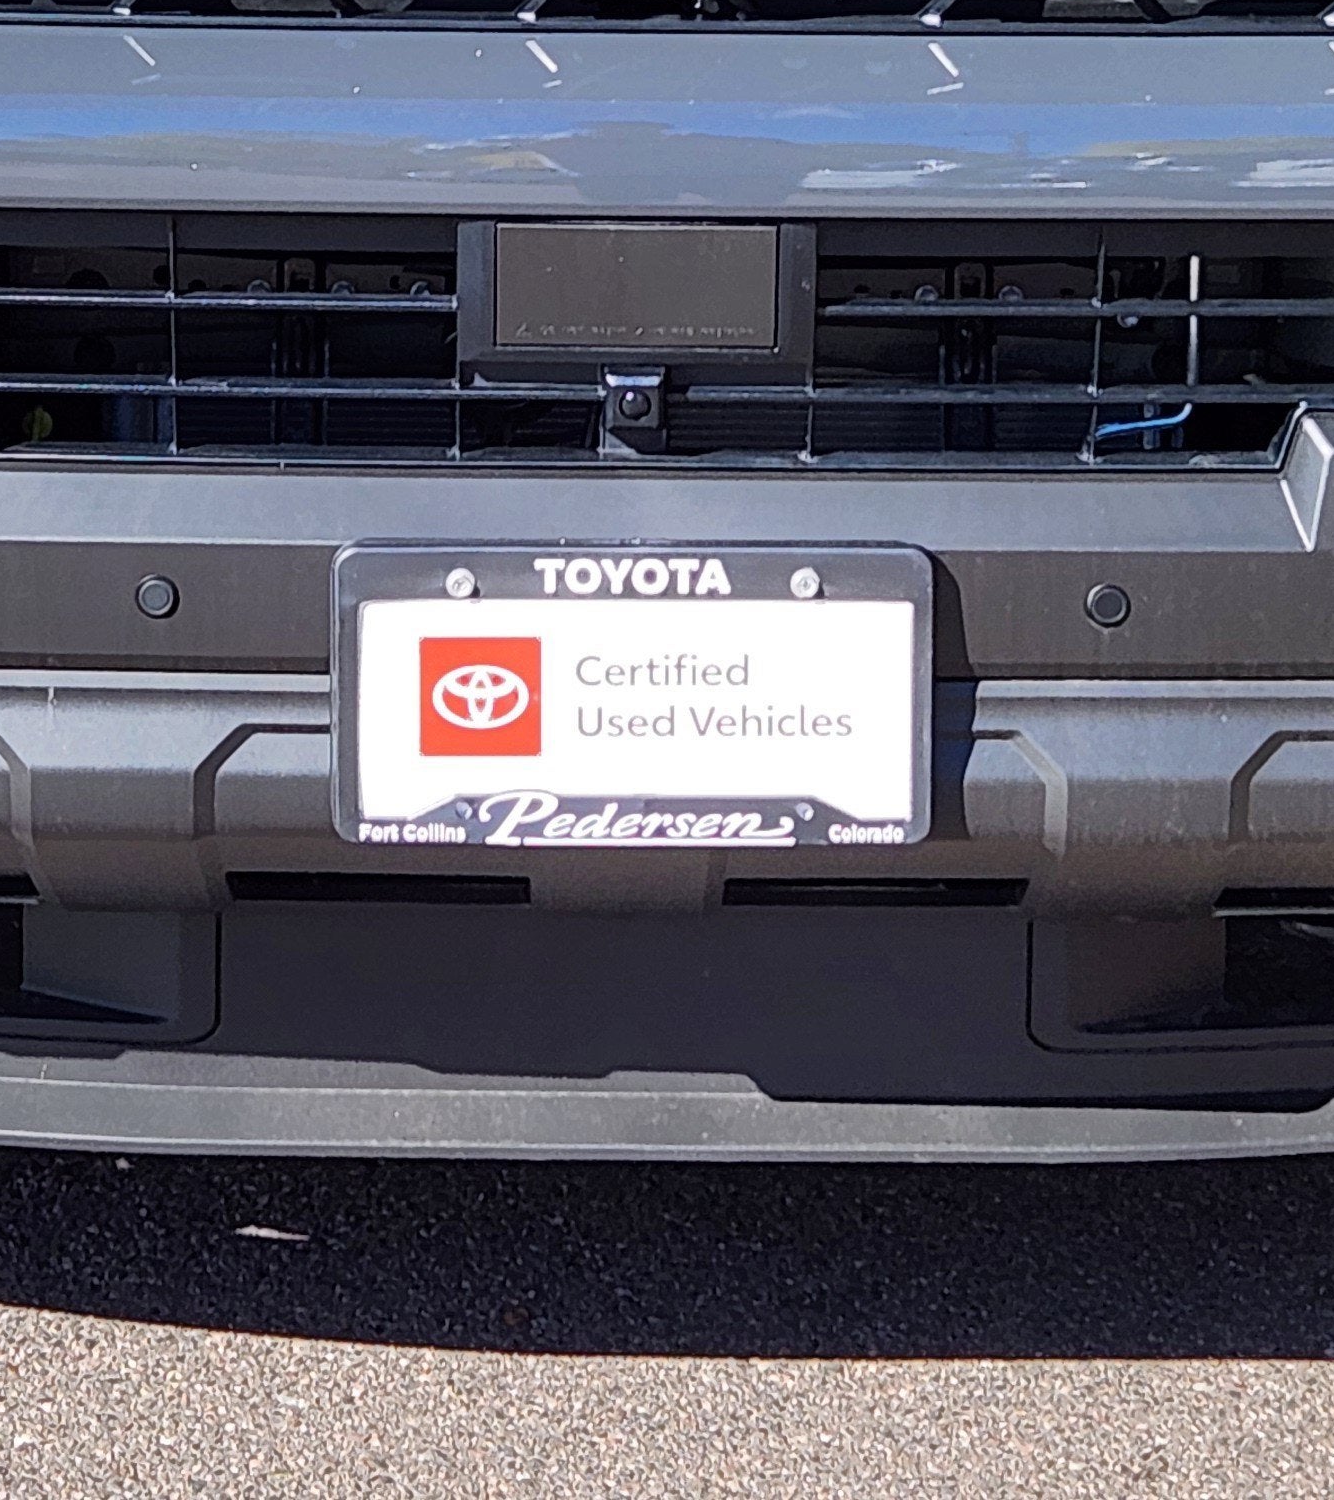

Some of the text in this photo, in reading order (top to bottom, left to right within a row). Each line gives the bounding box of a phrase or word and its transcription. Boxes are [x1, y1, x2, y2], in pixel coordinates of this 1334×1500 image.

[533, 557, 731, 596] TOYOTA
[575, 653, 750, 687] Certified
[577, 703, 854, 738] Used Vehicles
[357, 821, 467, 844] Fort Collins
[478, 789, 796, 847] Pedersen
[827, 822, 905, 844] Colorado
